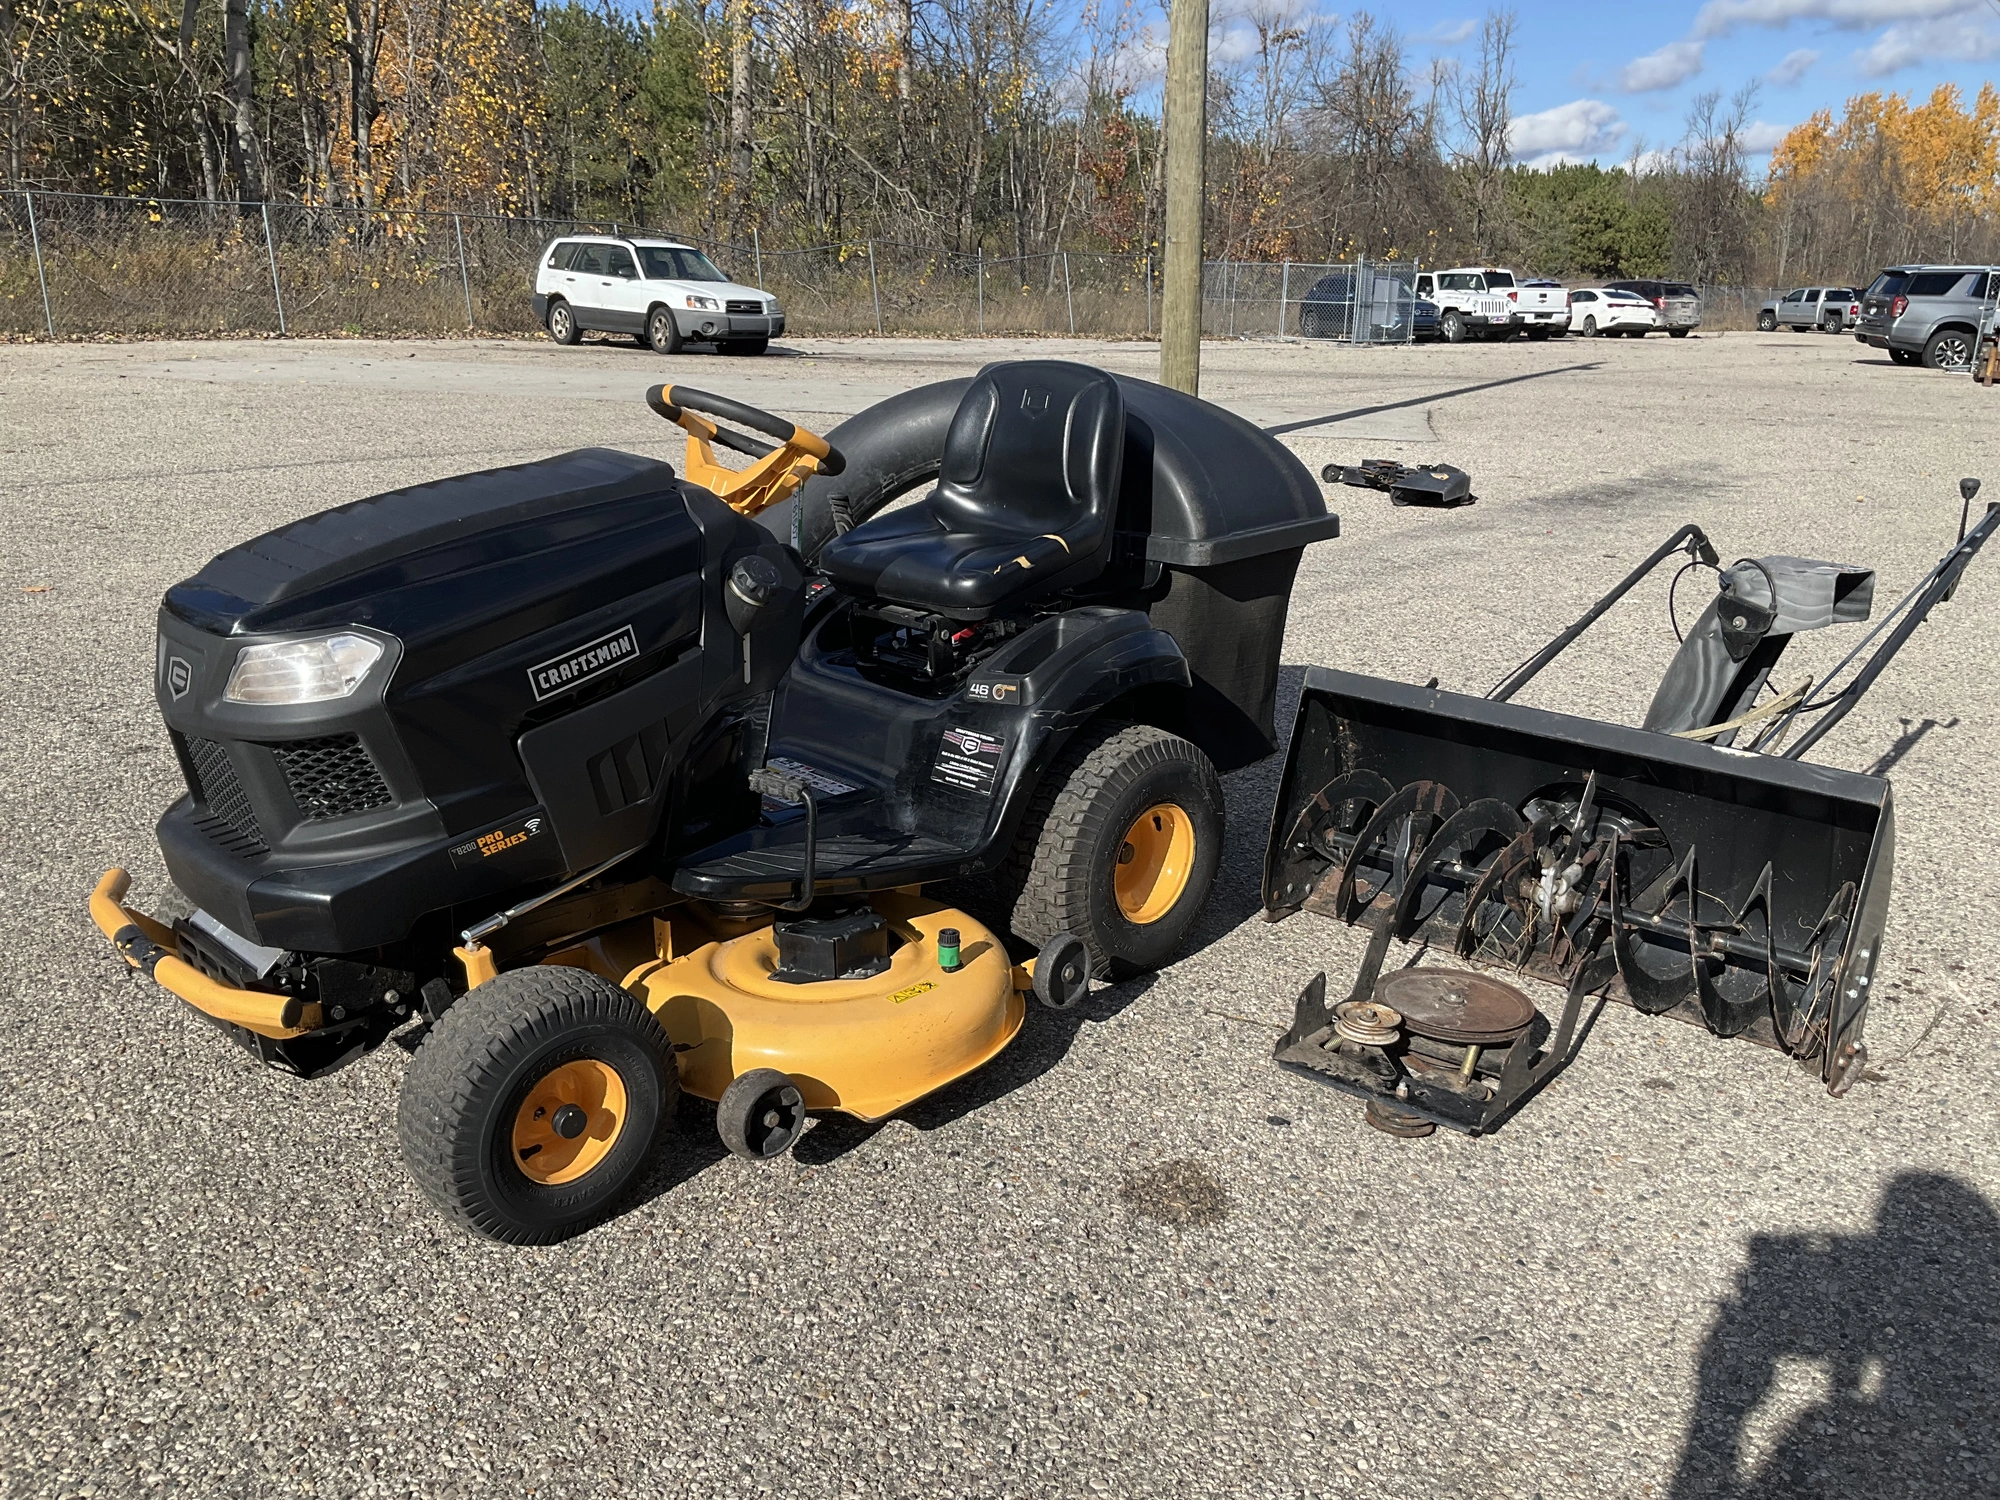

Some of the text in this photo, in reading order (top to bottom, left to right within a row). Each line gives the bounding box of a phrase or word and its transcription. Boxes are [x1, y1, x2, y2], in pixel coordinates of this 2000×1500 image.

[538, 635, 632, 690] CRAFTSMAN
[970, 683, 990, 696] 46
[476, 830, 504, 848] PRO
[481, 831, 528, 858] SERIES
